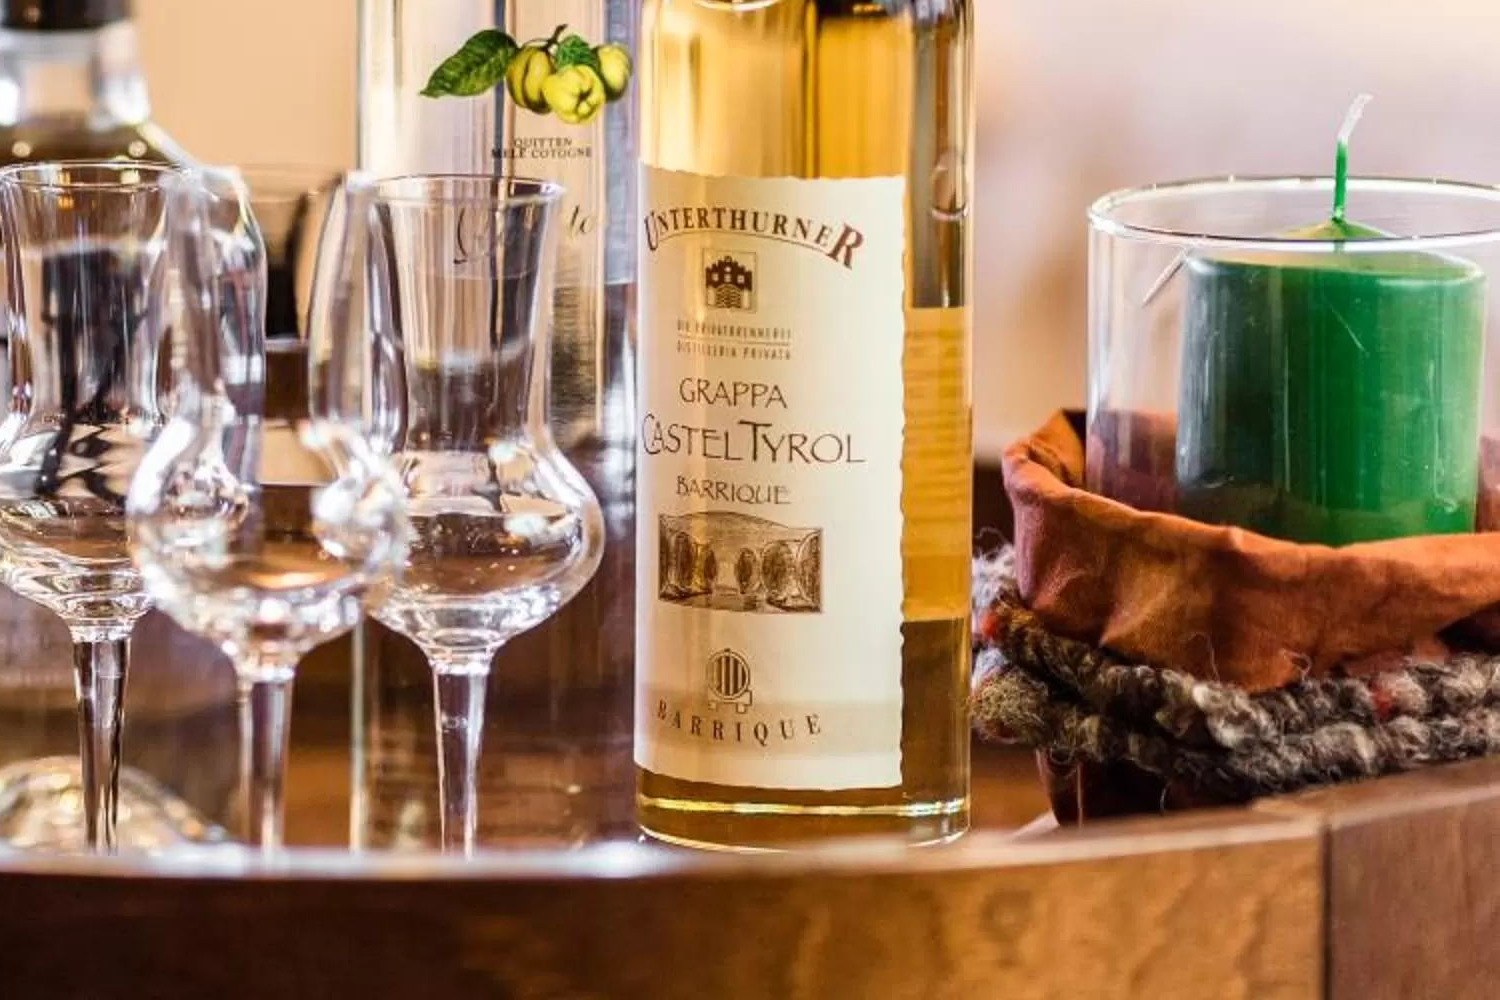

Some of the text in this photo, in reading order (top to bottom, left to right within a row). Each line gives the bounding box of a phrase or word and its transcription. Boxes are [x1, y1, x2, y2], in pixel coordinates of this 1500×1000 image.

[643, 206, 865, 271] UNTERTHURNER
[678, 377, 788, 410] GRAPPA
[676, 475, 792, 505] BARRIQUE
[656, 699, 822, 747] BARRIQUE
